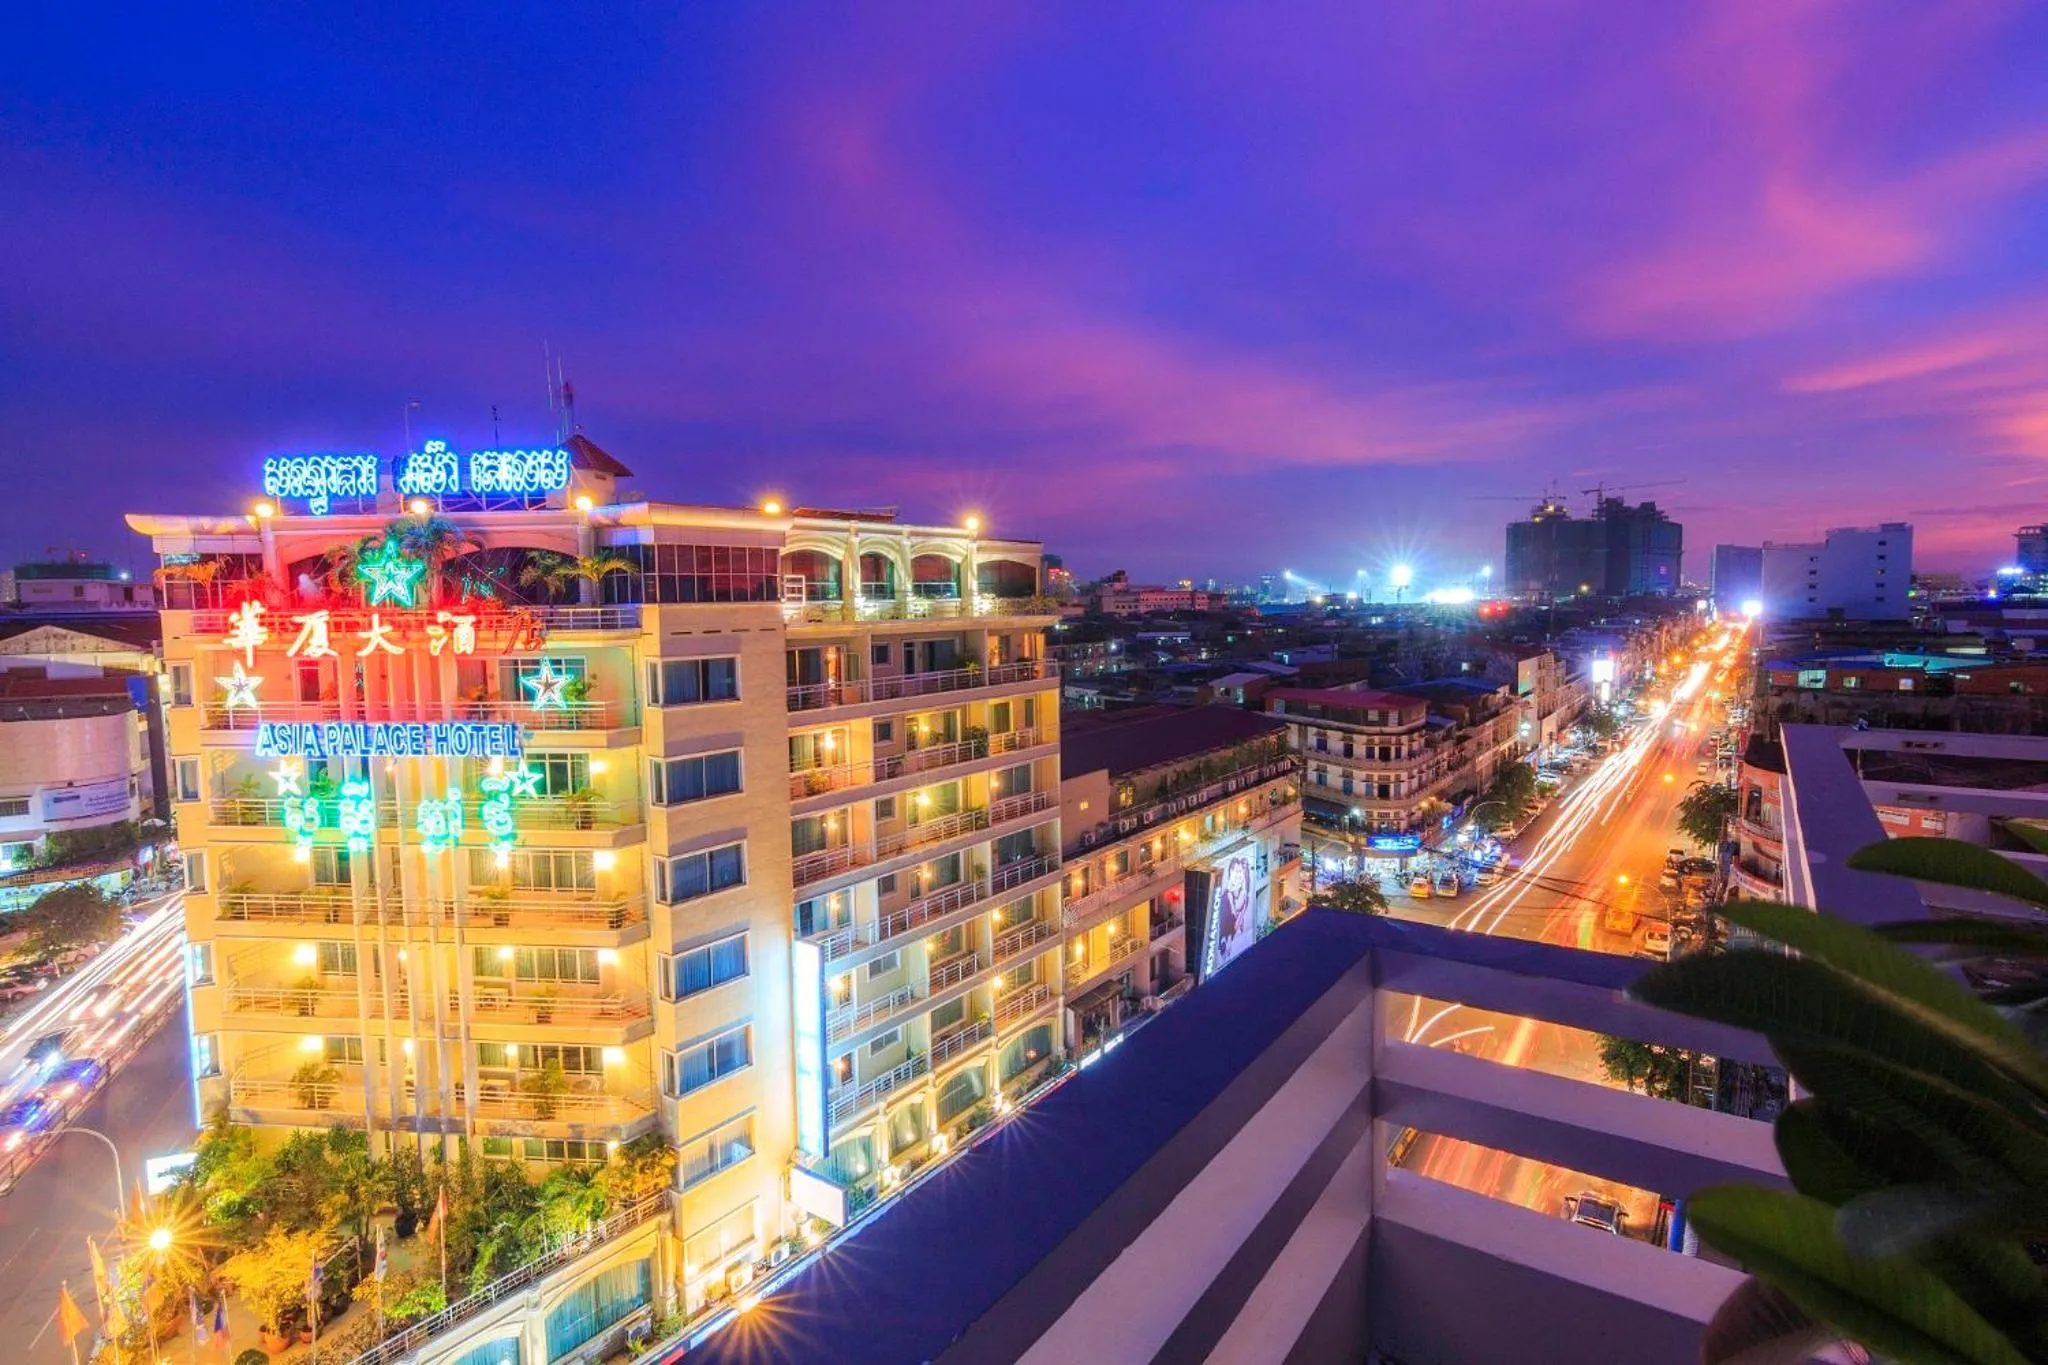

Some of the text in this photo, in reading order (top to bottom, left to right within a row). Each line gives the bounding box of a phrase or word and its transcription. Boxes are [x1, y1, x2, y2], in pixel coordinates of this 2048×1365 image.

[256, 722, 521, 758] ASIA PALACE HOTEL
